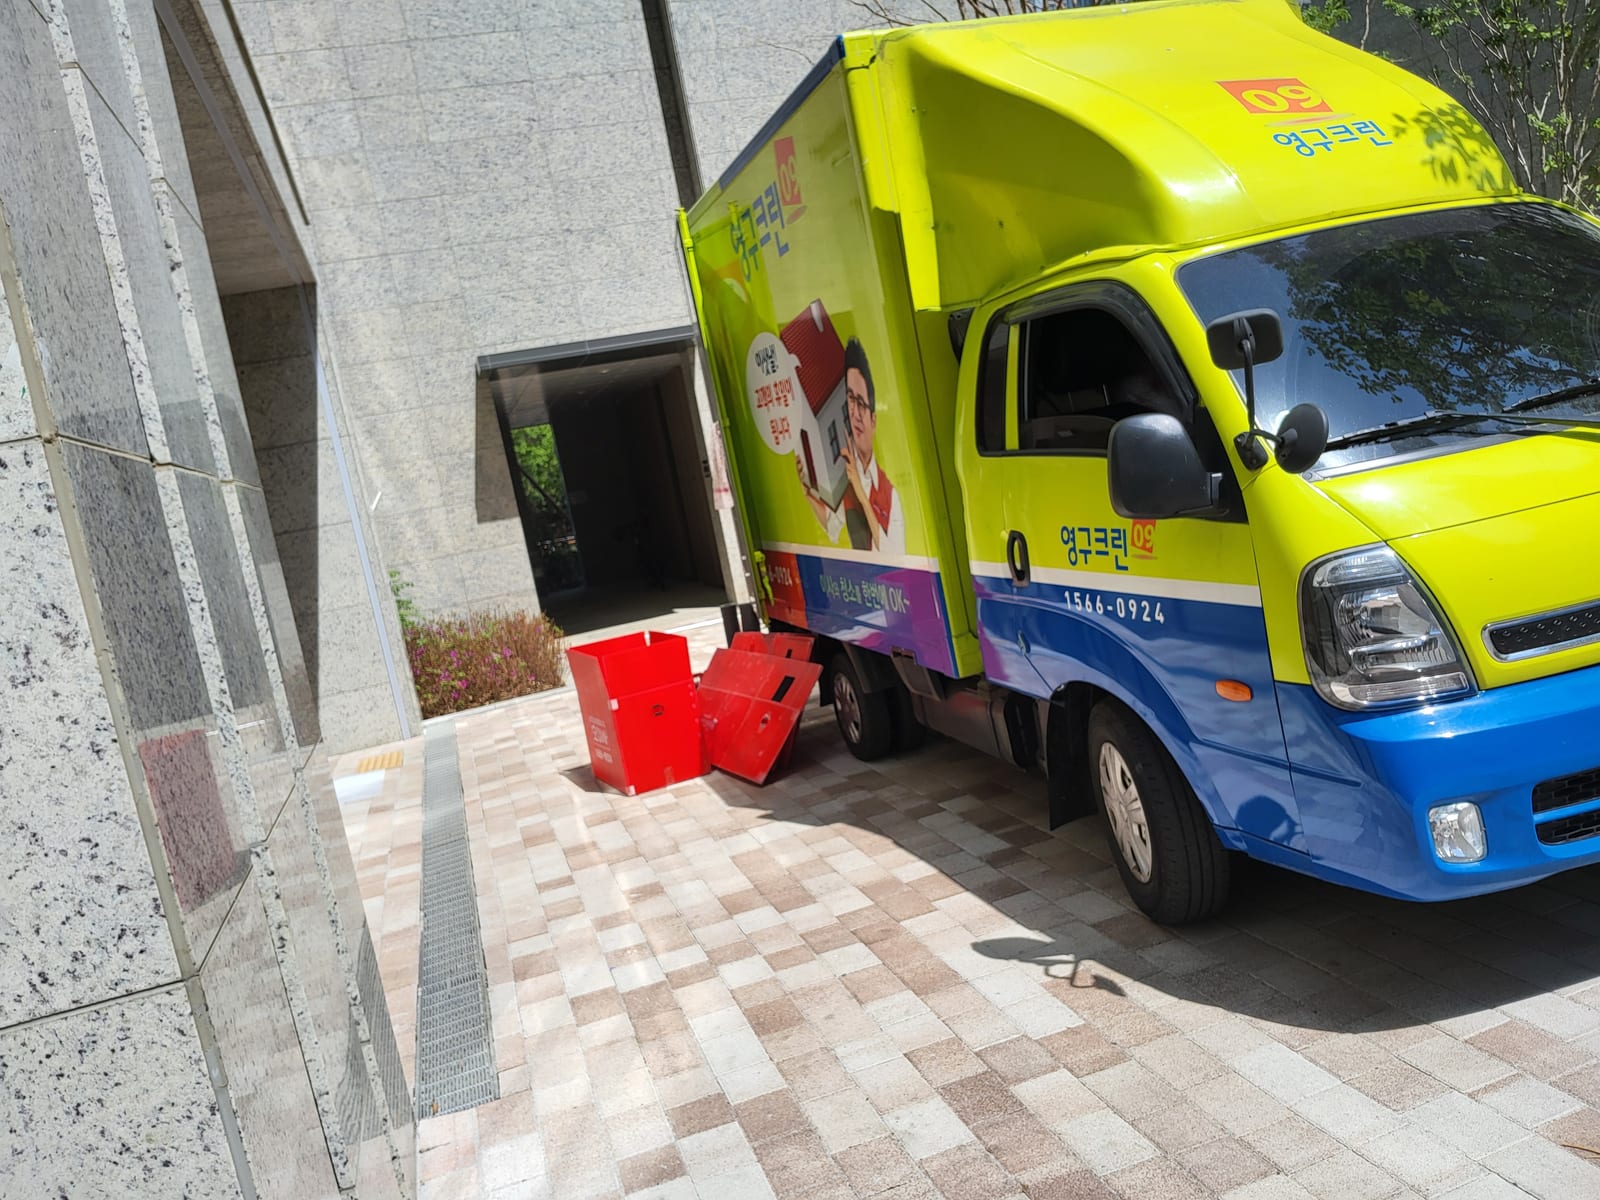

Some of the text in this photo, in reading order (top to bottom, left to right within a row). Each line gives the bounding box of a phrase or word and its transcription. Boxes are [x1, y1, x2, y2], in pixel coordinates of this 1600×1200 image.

[1241, 85, 1323, 112] 09
[1272, 120, 1394, 157] 영구크린
[729, 181, 790, 283] 영구크린
[1060, 524, 1154, 571] 영구크린 09
[1064, 590, 1165, 624] 1566-0924
